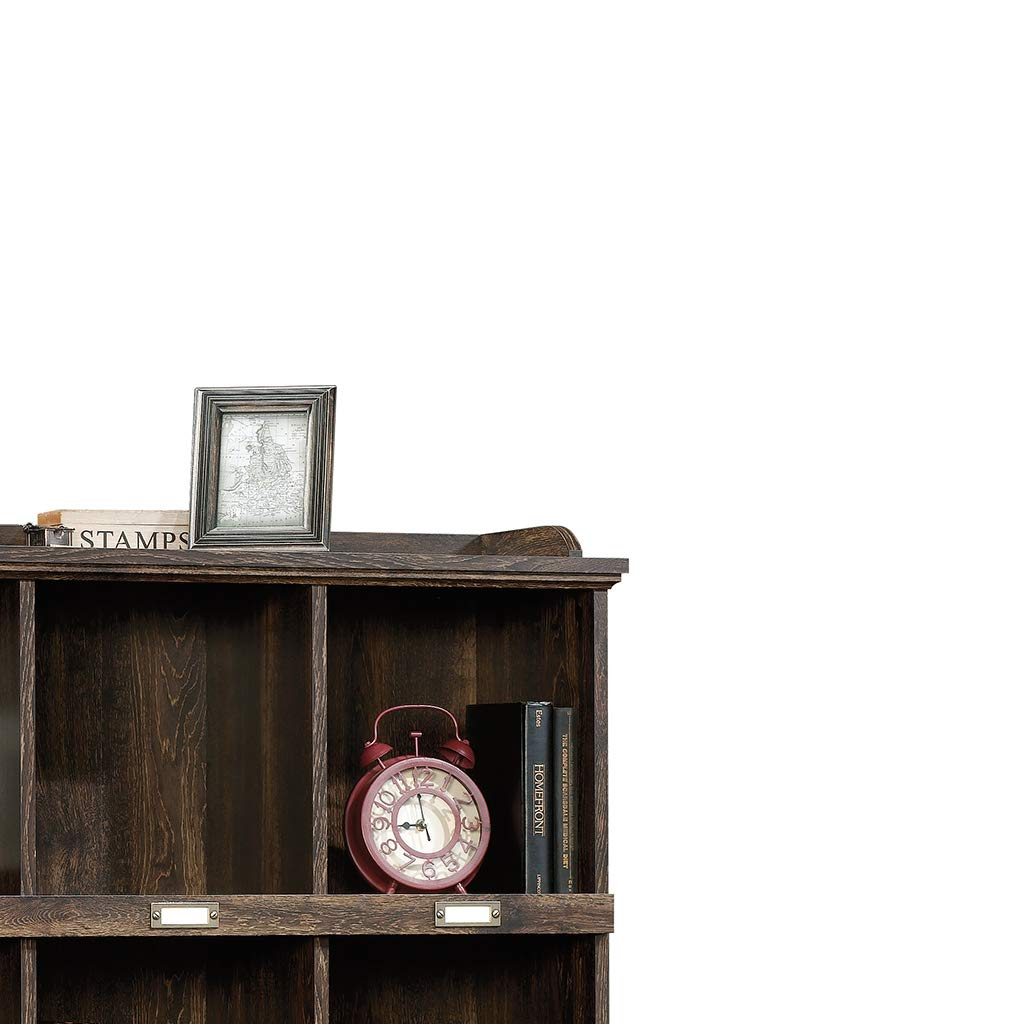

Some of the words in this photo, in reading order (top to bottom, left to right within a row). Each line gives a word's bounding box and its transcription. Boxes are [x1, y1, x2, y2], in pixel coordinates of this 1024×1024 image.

[80, 530, 189, 550] STAMPS
[412, 767, 435, 788] 12
[374, 790, 396, 813] 10
[534, 764, 544, 836] HOMEFRONT
[372, 816, 390, 831] 9
[381, 838, 397, 855] 8
[400, 852, 416, 872] 7
[422, 861, 436, 879] 6
[441, 850, 459, 872] 5
